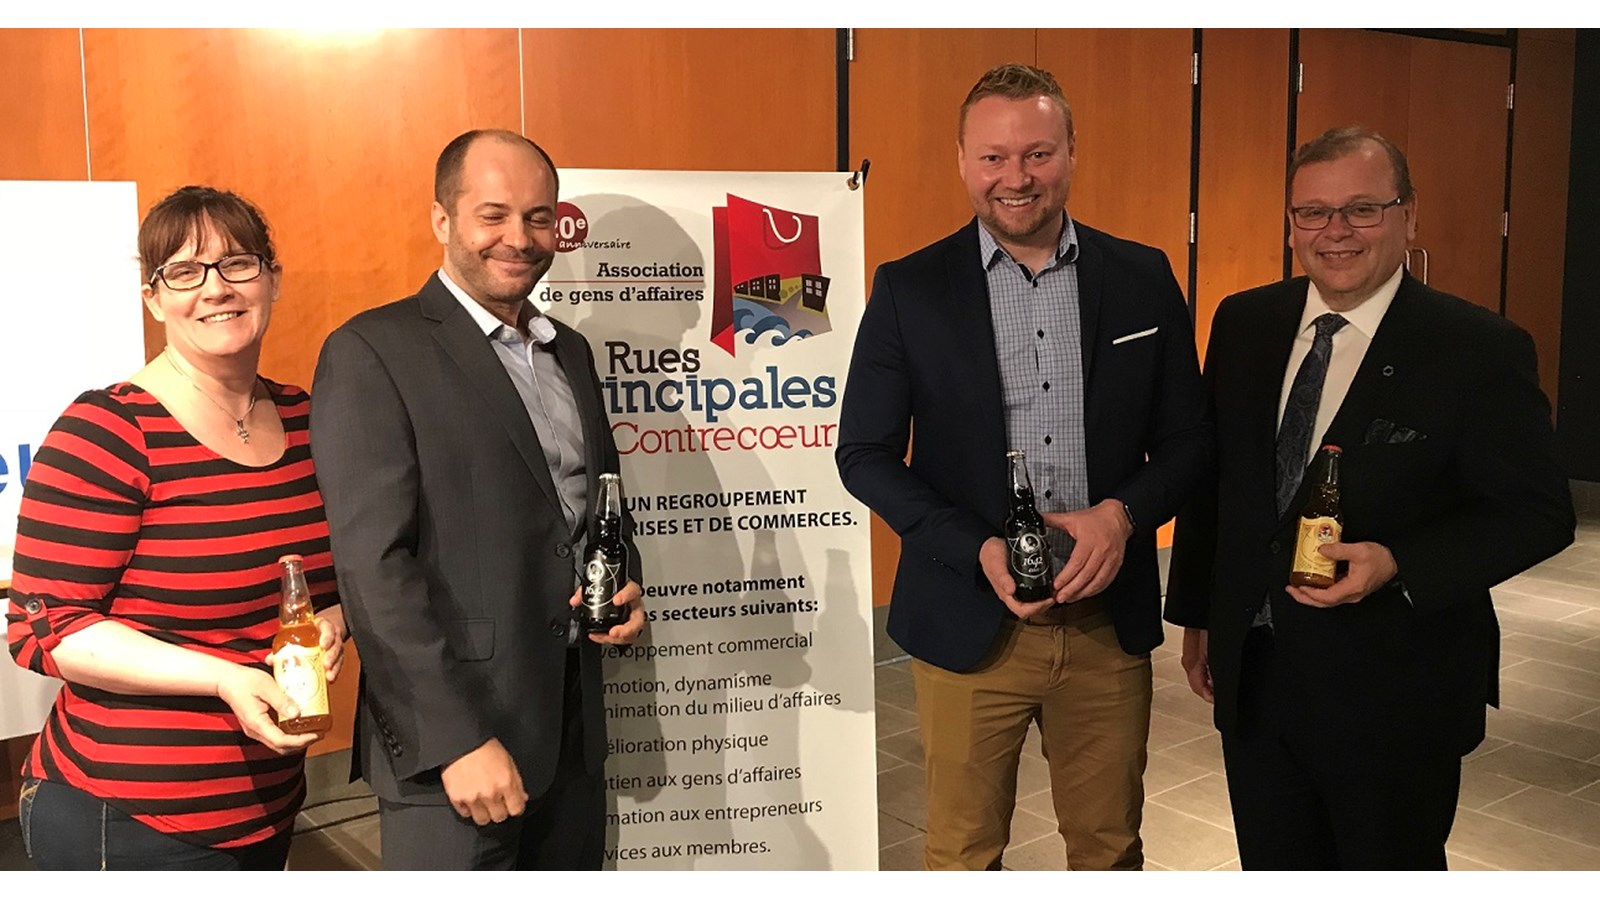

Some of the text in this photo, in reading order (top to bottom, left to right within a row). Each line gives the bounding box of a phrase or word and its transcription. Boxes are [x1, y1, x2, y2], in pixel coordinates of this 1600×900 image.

[554, 216, 586, 239] 0e
[559, 238, 631, 249] anniversaire
[597, 262, 704, 277] Association
[540, 287, 704, 305] de gens d'affaires
[605, 341, 700, 374] Rues
[601, 366, 836, 423] incipales
[610, 421, 837, 455] Contrecœur
[624, 489, 807, 511] UN REGROUPEMENT
[683, 518, 704, 534] ET
[709, 516, 732, 532] DE
[737, 511, 857, 531] COMMERCES.
[703, 575, 805, 595] notamment
[662, 604, 736, 621] secteurs
[741, 598, 818, 617] suivants:
[718, 632, 813, 654] commercial
[603, 672, 772, 695] motion, dynamisme
[605, 692, 841, 719] nimation du milieu d'affaires
[692, 734, 768, 755] physique
[647, 774, 677, 787] aux
[682, 771, 722, 790] gens
[728, 765, 801, 784] d'affaires
[670, 808, 700, 821] aux
[705, 800, 823, 822] entrepreneurs
[604, 839, 771, 861] vices aux membres.
